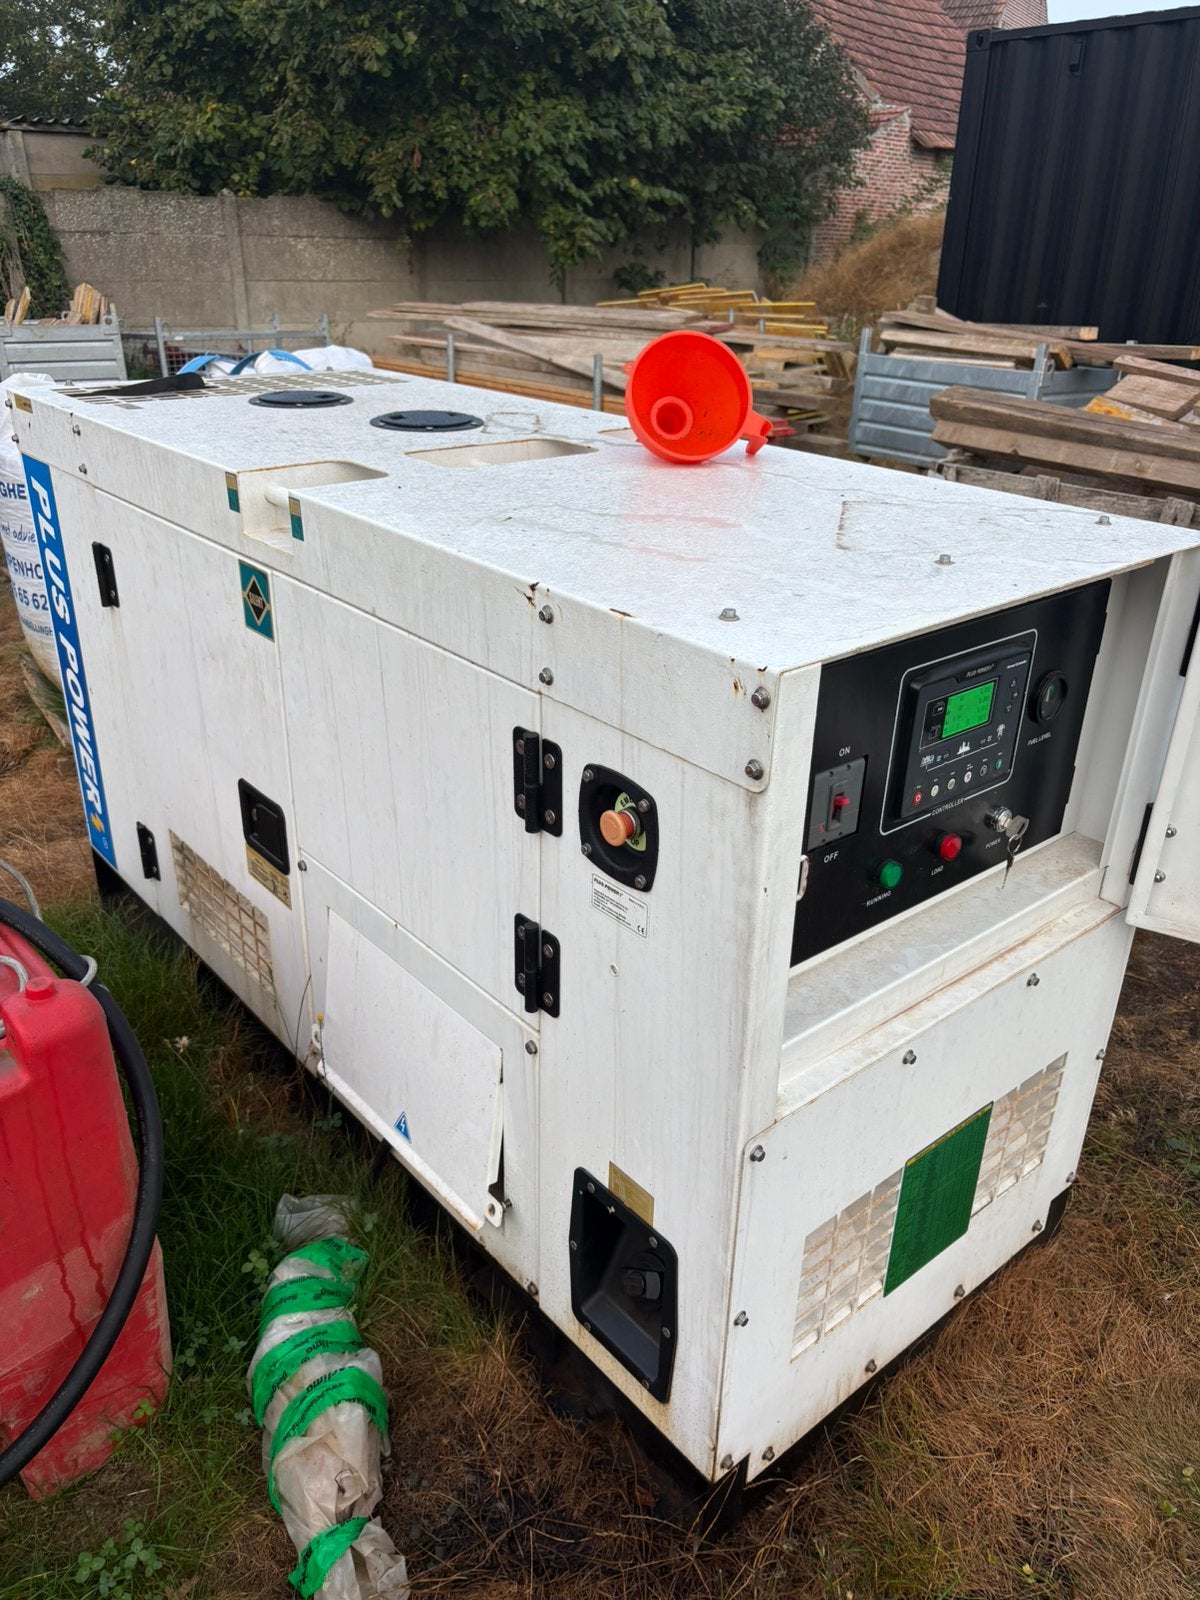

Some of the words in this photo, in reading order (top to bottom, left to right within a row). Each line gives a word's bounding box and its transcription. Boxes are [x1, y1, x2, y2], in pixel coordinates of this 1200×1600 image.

[32, 593, 49, 611] 62
[30, 475, 71, 625] PLUS
[59, 631, 102, 815] POWER
[1027, 738, 1038, 746] FUEL
[1038, 731, 1052, 742] LEVEL
[838, 746, 851, 757] ON
[931, 797, 965, 816] CONTROLLER
[985, 837, 1002, 849] POWER
[823, 850, 840, 863] OFF
[931, 865, 944, 876] LOAD
[593, 877, 605, 888] PLUS
[865, 889, 892, 907] RUNNING
